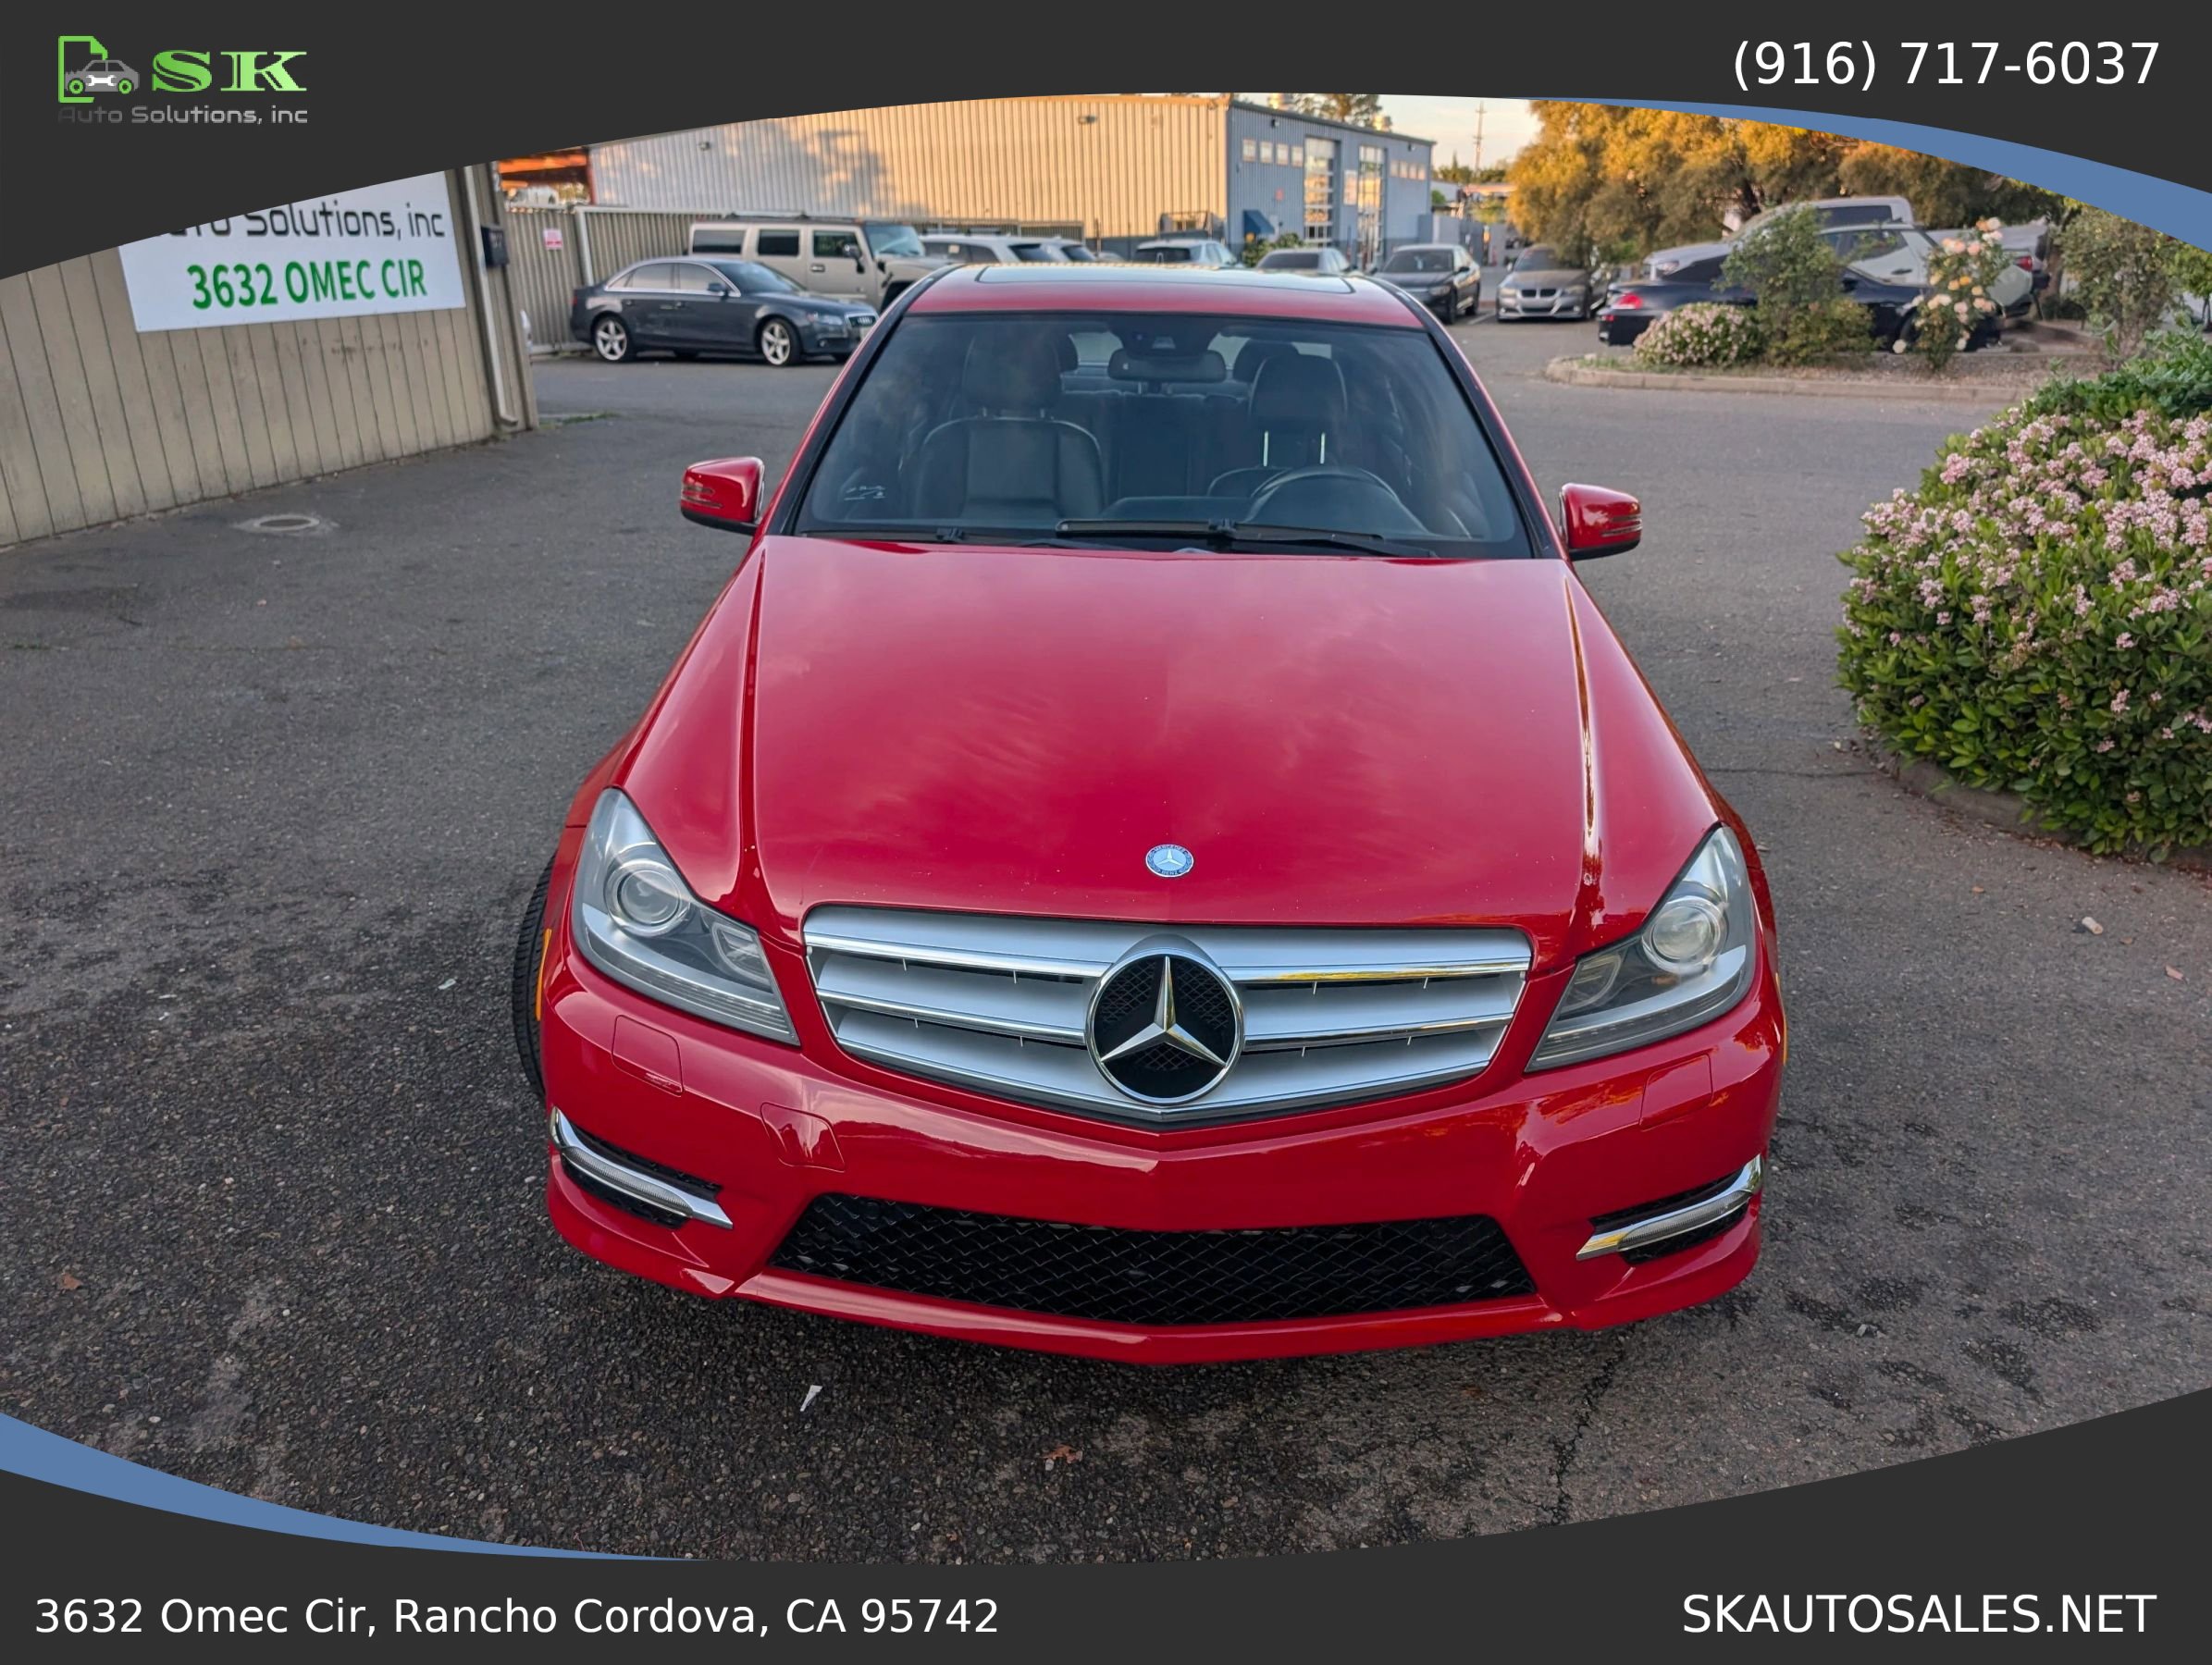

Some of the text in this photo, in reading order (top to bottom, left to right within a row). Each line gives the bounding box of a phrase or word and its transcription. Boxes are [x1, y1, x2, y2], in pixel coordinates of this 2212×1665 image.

[244, 199, 402, 240] Solutions,
[406, 202, 446, 238] inc
[187, 258, 428, 310] 3632 OMEC CIR
